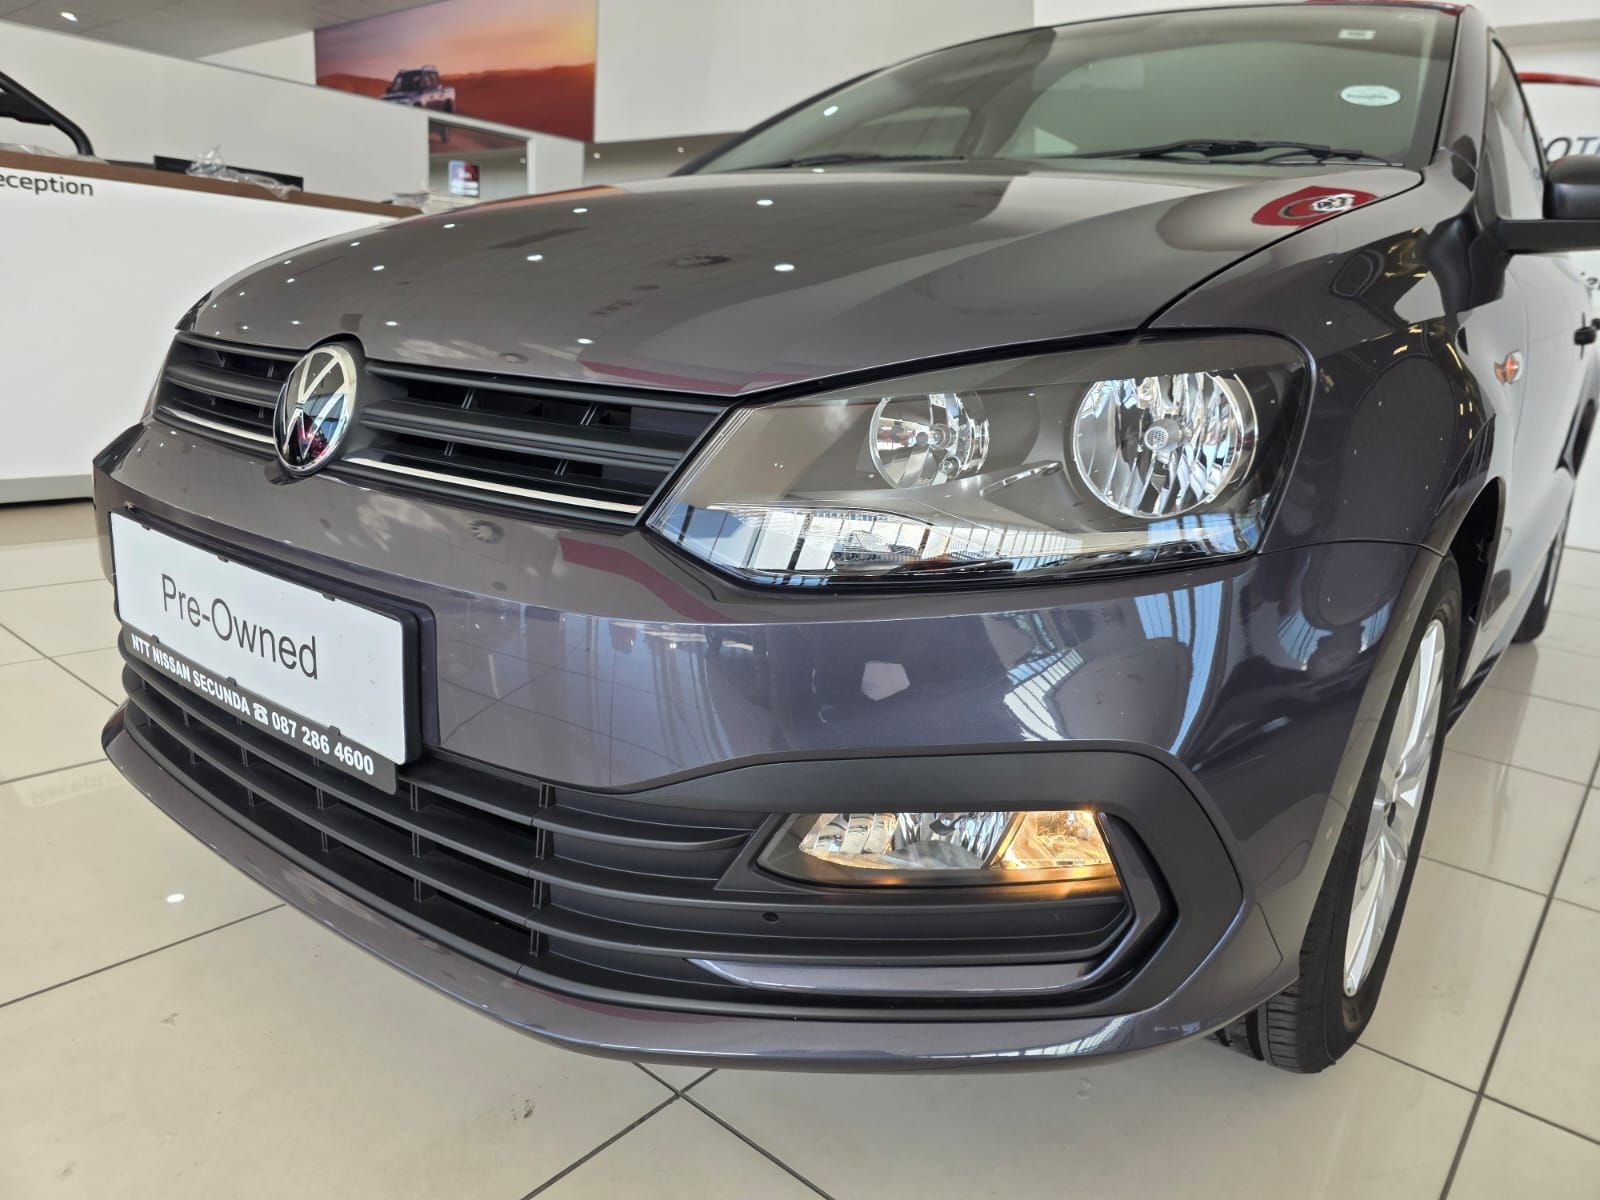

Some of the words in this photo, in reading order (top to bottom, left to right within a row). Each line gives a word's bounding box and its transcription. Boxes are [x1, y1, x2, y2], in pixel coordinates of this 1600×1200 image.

[161, 573, 317, 680] Pre-Owned
[131, 633, 150, 658] NTT
[152, 645, 191, 682] NISSAN
[193, 670, 251, 716] SECUNDA
[271, 711, 297, 738] 087
[301, 726, 330, 754] 286
[334, 742, 375, 776] 4600
